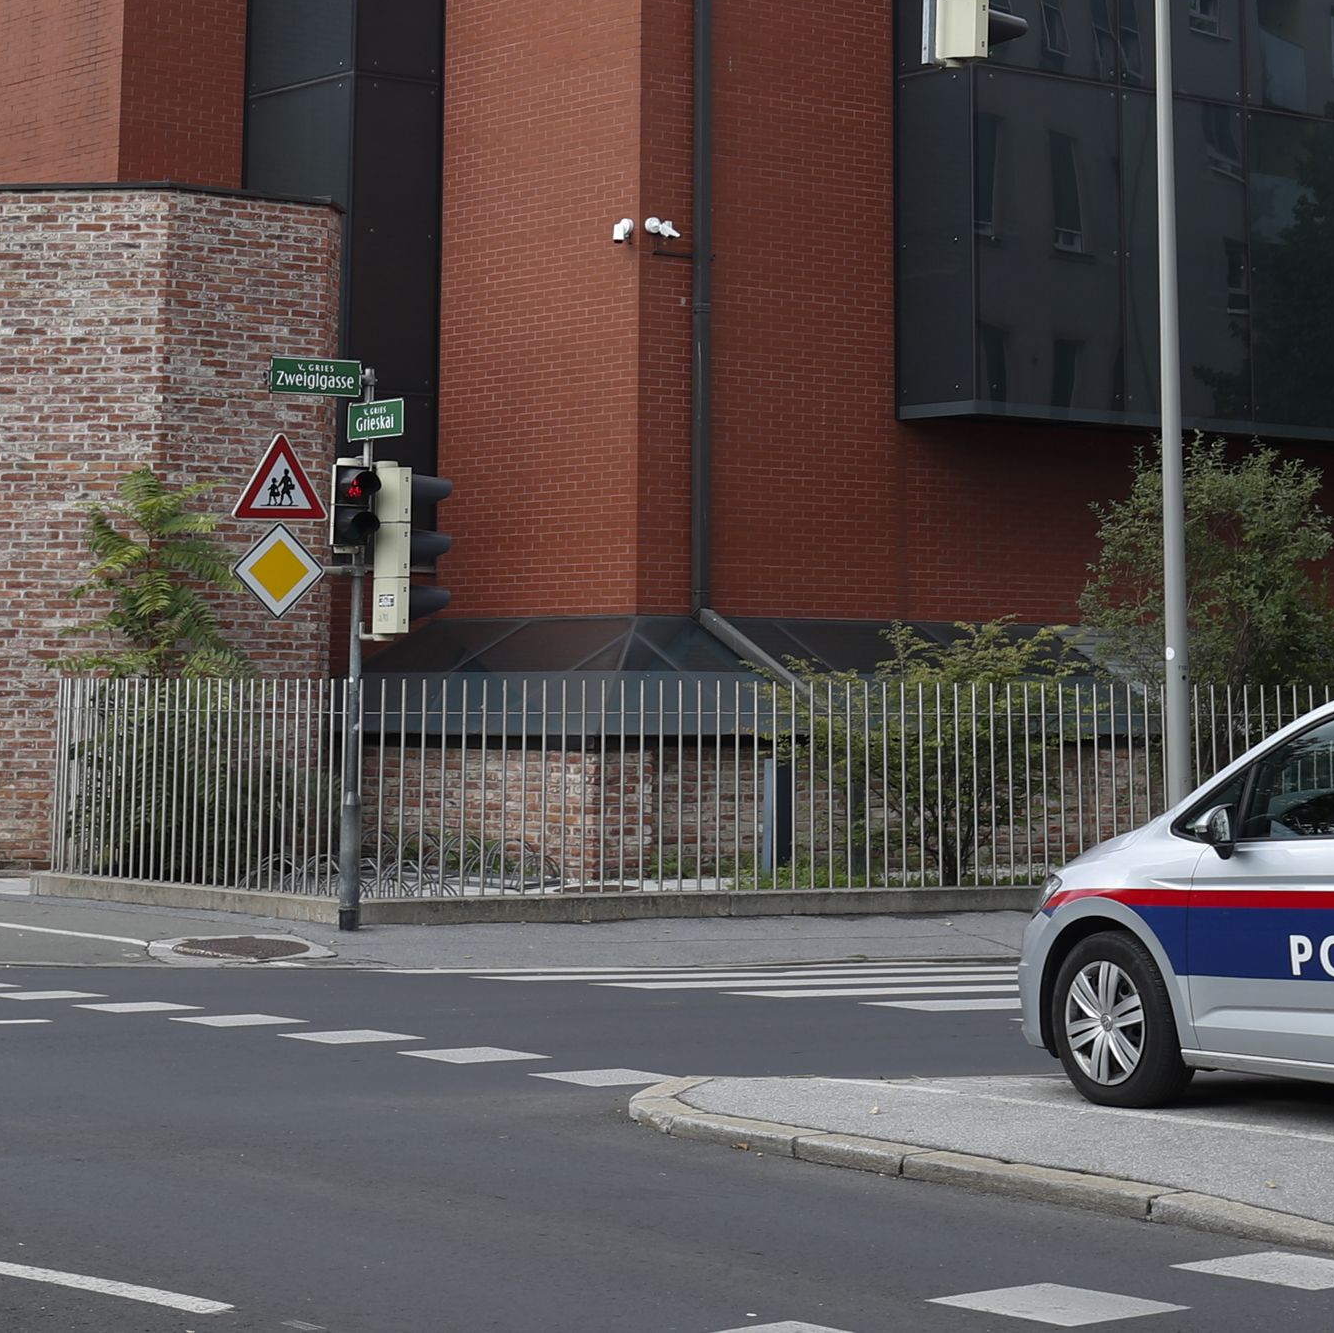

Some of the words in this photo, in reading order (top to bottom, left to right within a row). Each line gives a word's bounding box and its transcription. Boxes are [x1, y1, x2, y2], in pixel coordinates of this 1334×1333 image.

[308, 364, 334, 372] GRIES
[276, 370, 355, 391] Zweiglgasse
[369, 406, 387, 415] GRIES
[355, 414, 395, 432] Grieskai
